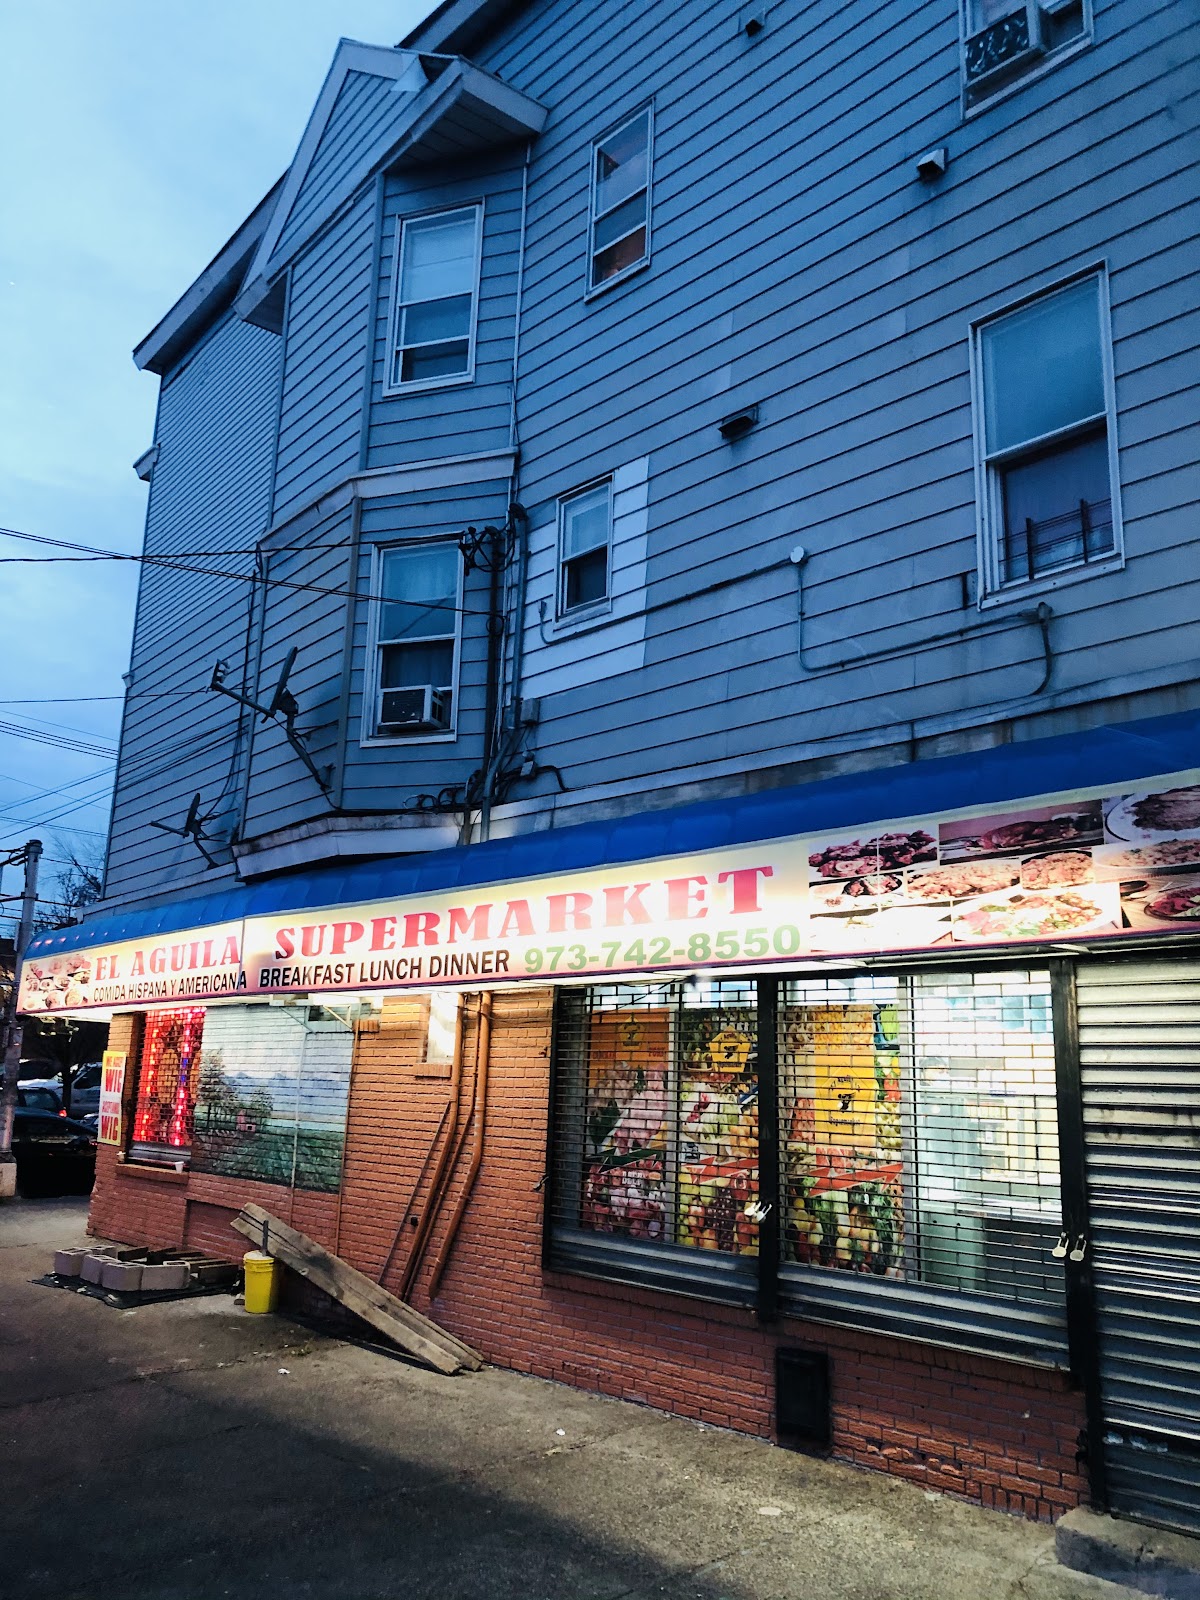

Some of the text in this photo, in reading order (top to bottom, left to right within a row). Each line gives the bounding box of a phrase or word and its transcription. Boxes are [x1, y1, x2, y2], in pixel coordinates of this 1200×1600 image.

[95, 865, 774, 981] EL AGUILA SUPERMARKET
[524, 924, 801, 974] 973-742-8550
[93, 969, 247, 1003] COMIDA HISPANA Y AMERICANA
[258, 949, 510, 988] BREAKFAST LUNCH DINNER
[105, 1068, 123, 1093] WIC
[101, 1115, 119, 1141] WIC
